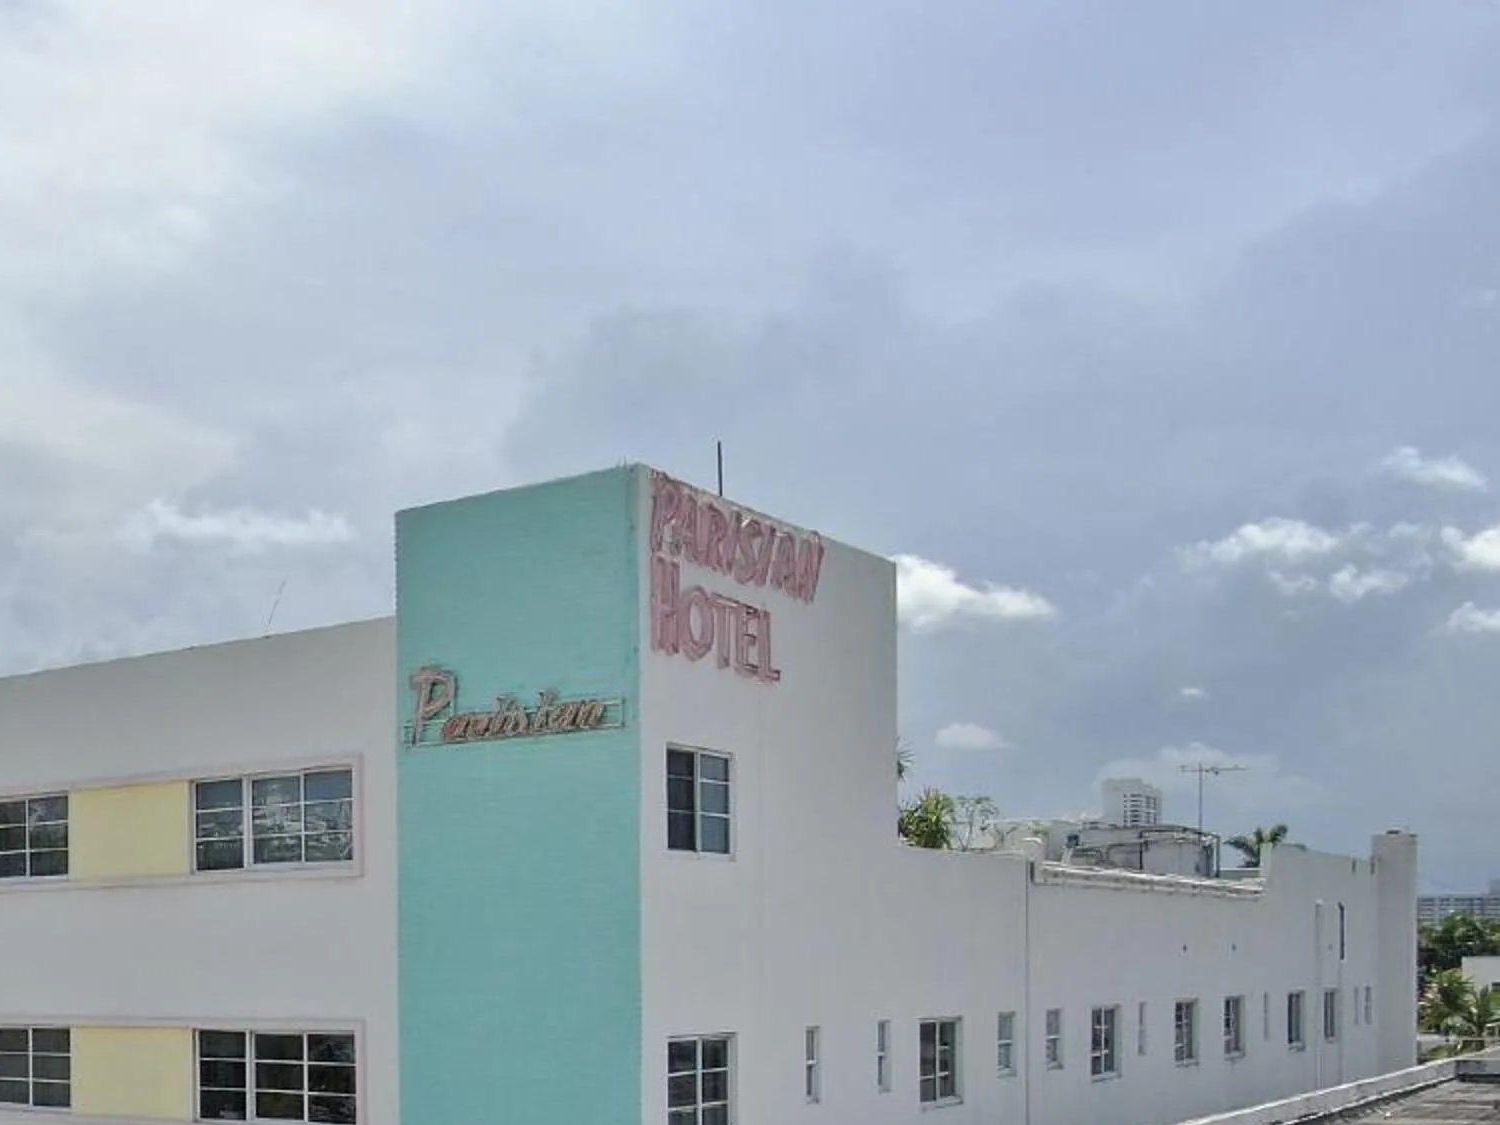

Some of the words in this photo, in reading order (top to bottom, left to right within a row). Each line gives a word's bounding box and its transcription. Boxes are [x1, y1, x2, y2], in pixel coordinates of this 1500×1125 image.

[651, 475, 825, 604] PARISIAN
[651, 554, 781, 682] HOTEL
[411, 666, 606, 745] Parisian
